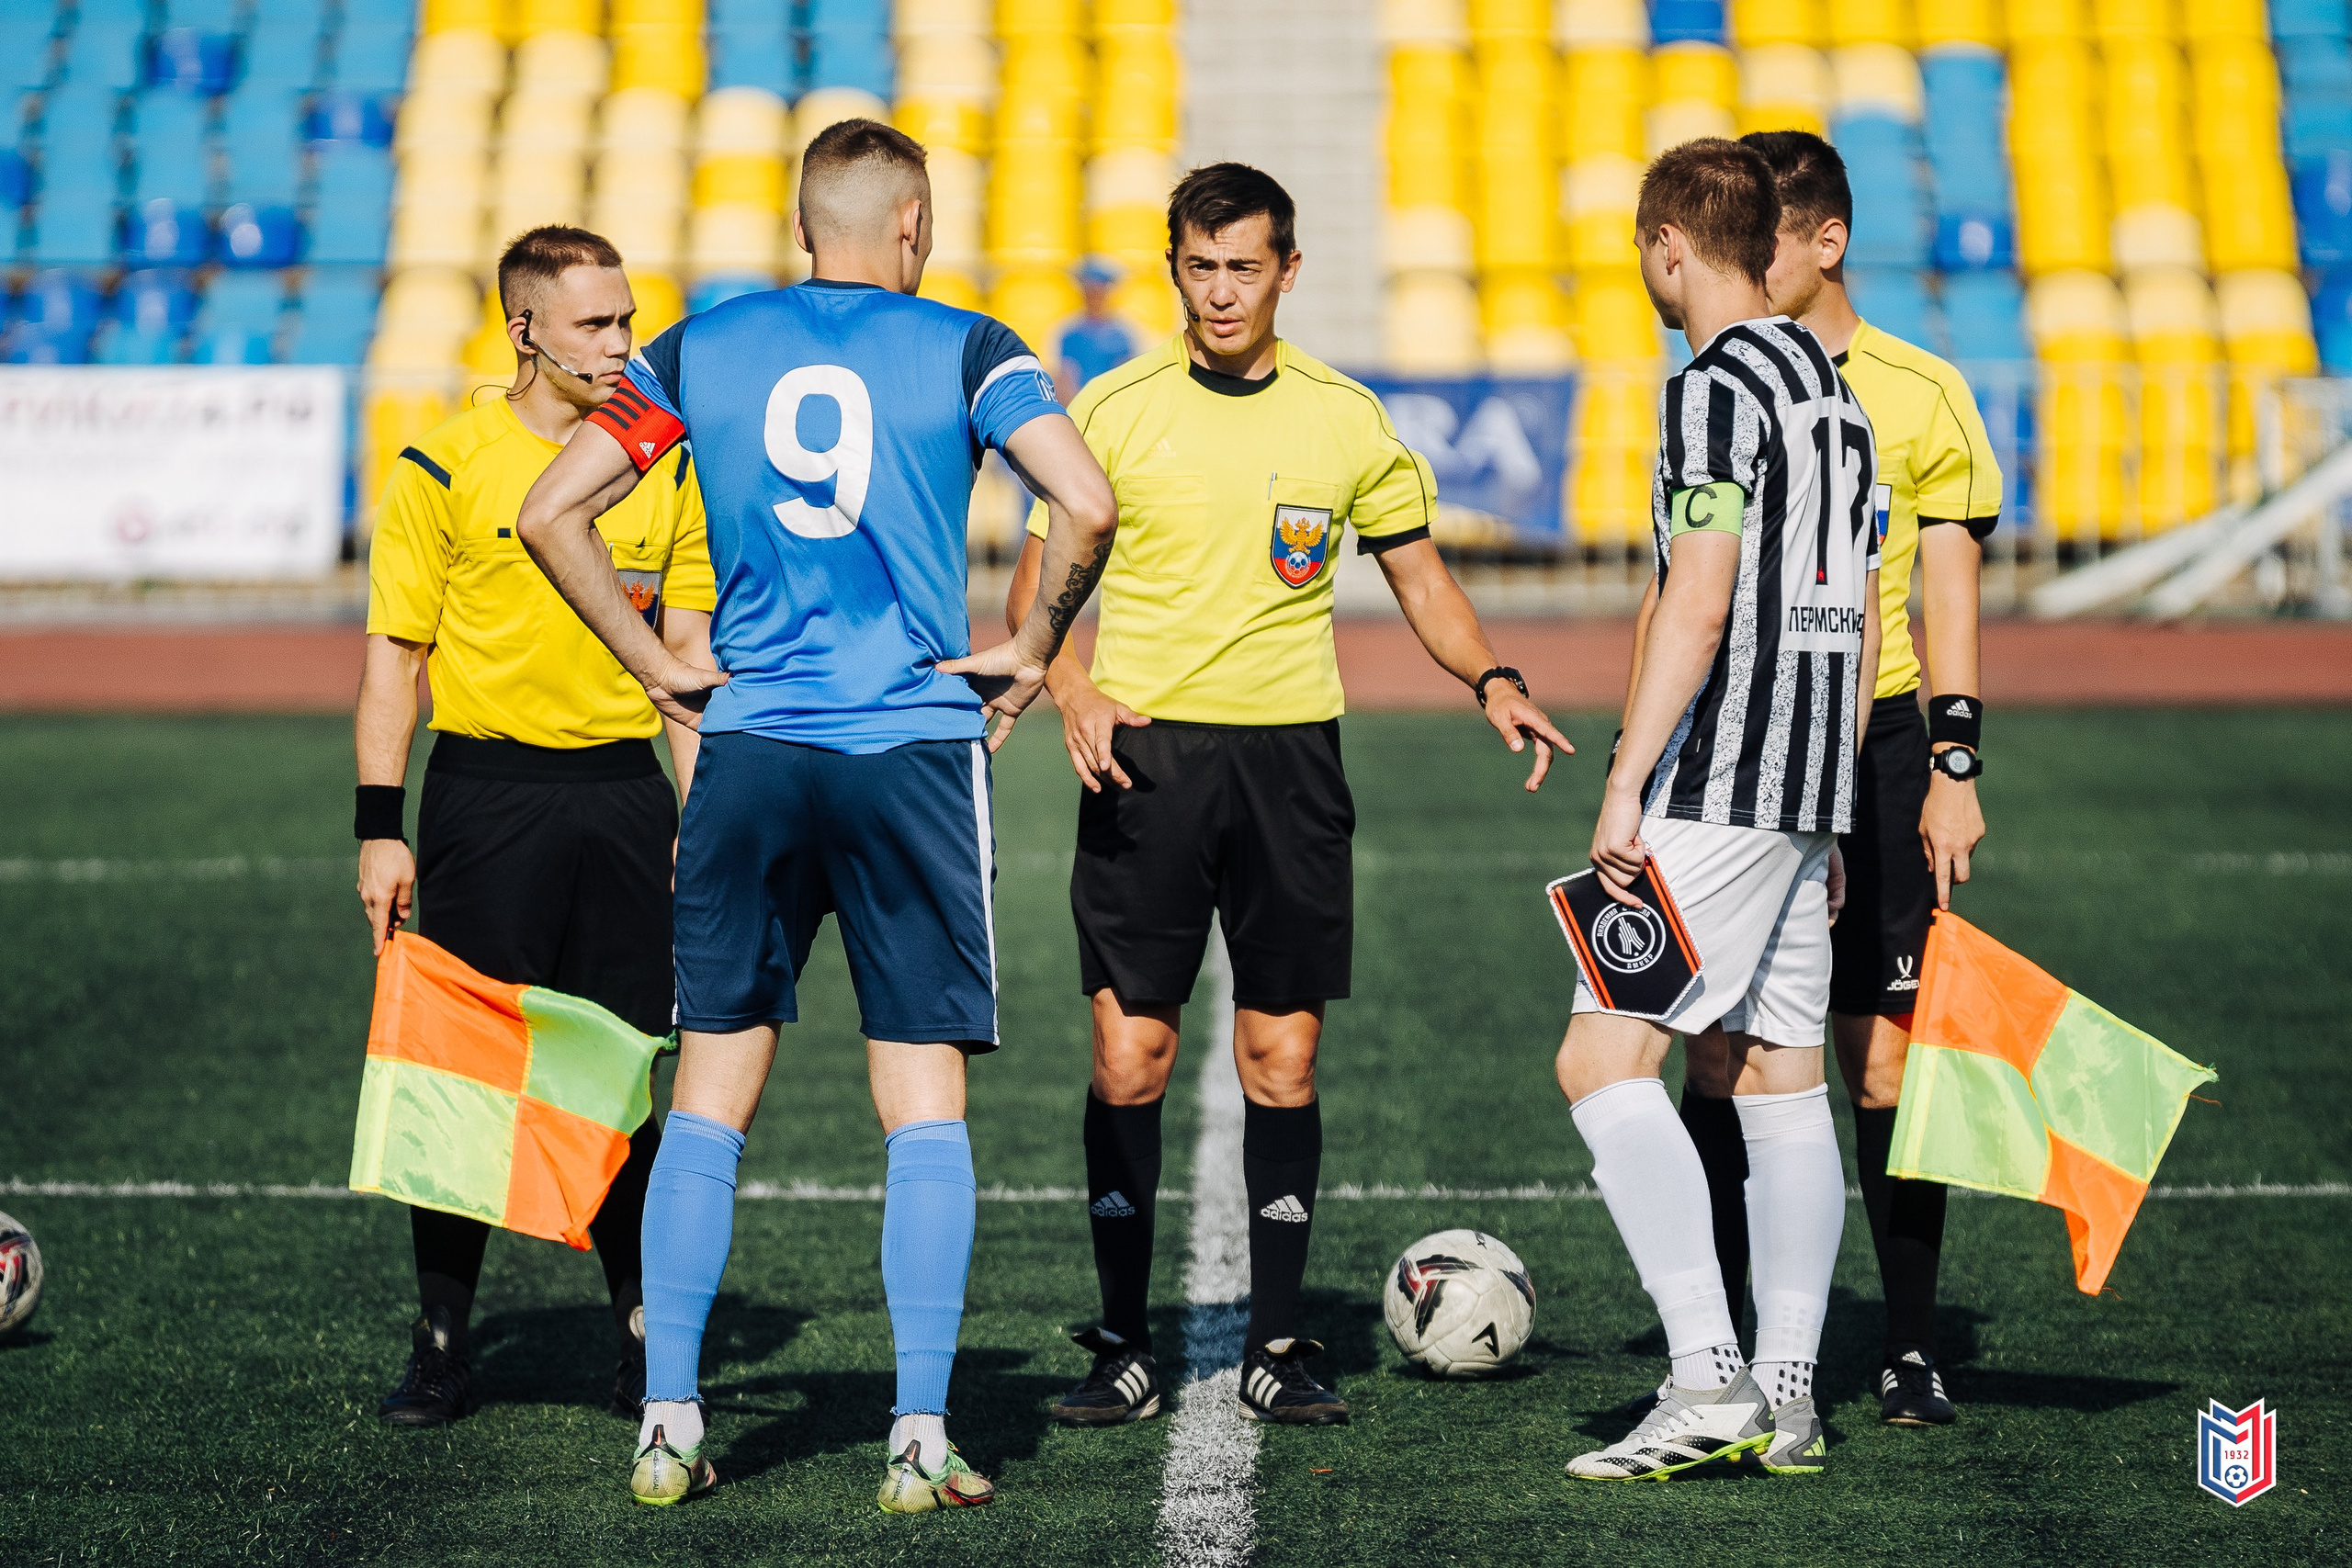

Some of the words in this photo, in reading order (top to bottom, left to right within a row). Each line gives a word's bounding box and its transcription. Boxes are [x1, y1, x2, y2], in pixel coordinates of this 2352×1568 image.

[763, 365, 874, 538] 9
[1685, 485, 1718, 529] C
[1811, 416, 1873, 585] 17
[1946, 708, 1973, 719] adidas
[1626, 953, 1655, 970] АМКАР
[1091, 1206, 1136, 1217] adidas
[1260, 1208, 1308, 1224] adidas
